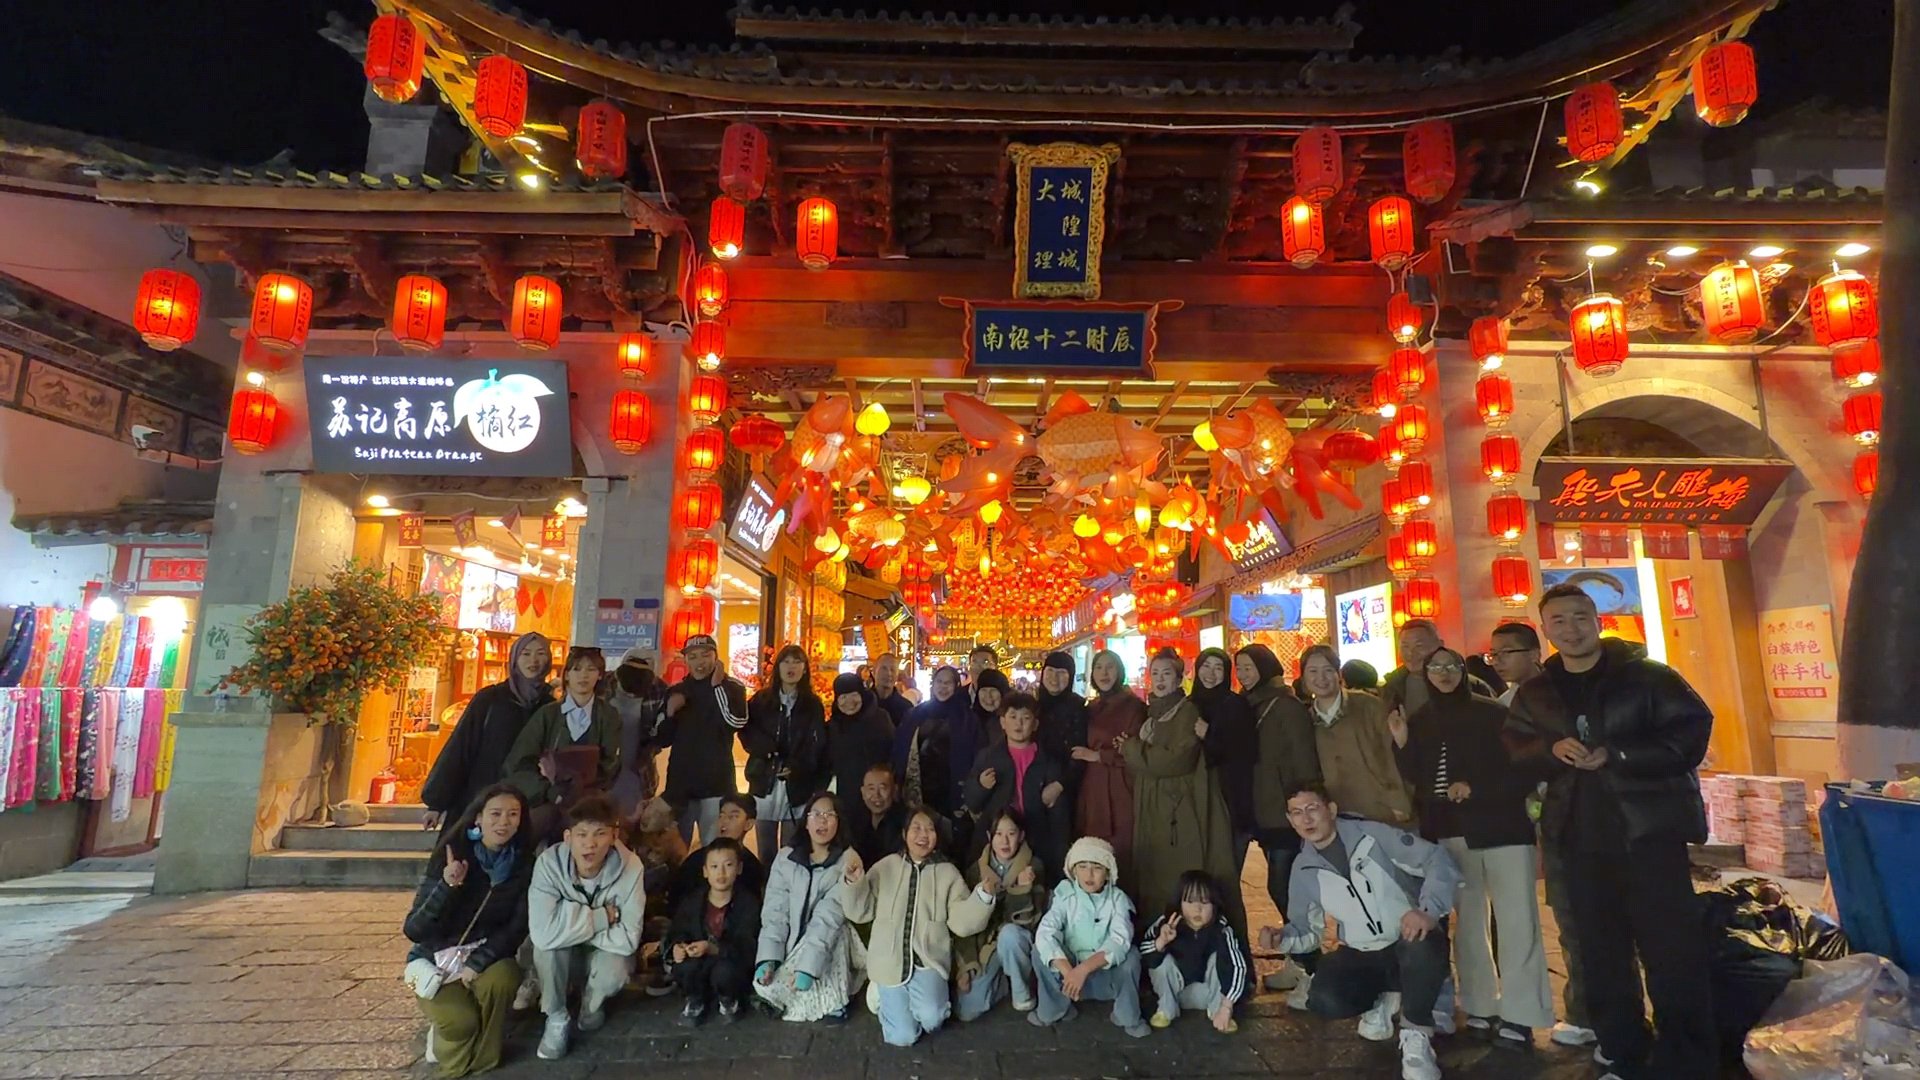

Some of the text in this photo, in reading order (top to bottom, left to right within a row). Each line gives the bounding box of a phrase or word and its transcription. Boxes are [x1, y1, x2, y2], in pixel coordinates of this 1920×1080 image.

[1034, 178, 1056, 269] 大理
[1057, 178, 1084, 272] 城隍城
[327, 396, 452, 439] 苏记高原
[1767, 640, 1821, 655] 白族特色
[1771, 661, 1832, 681] 伴手礼
